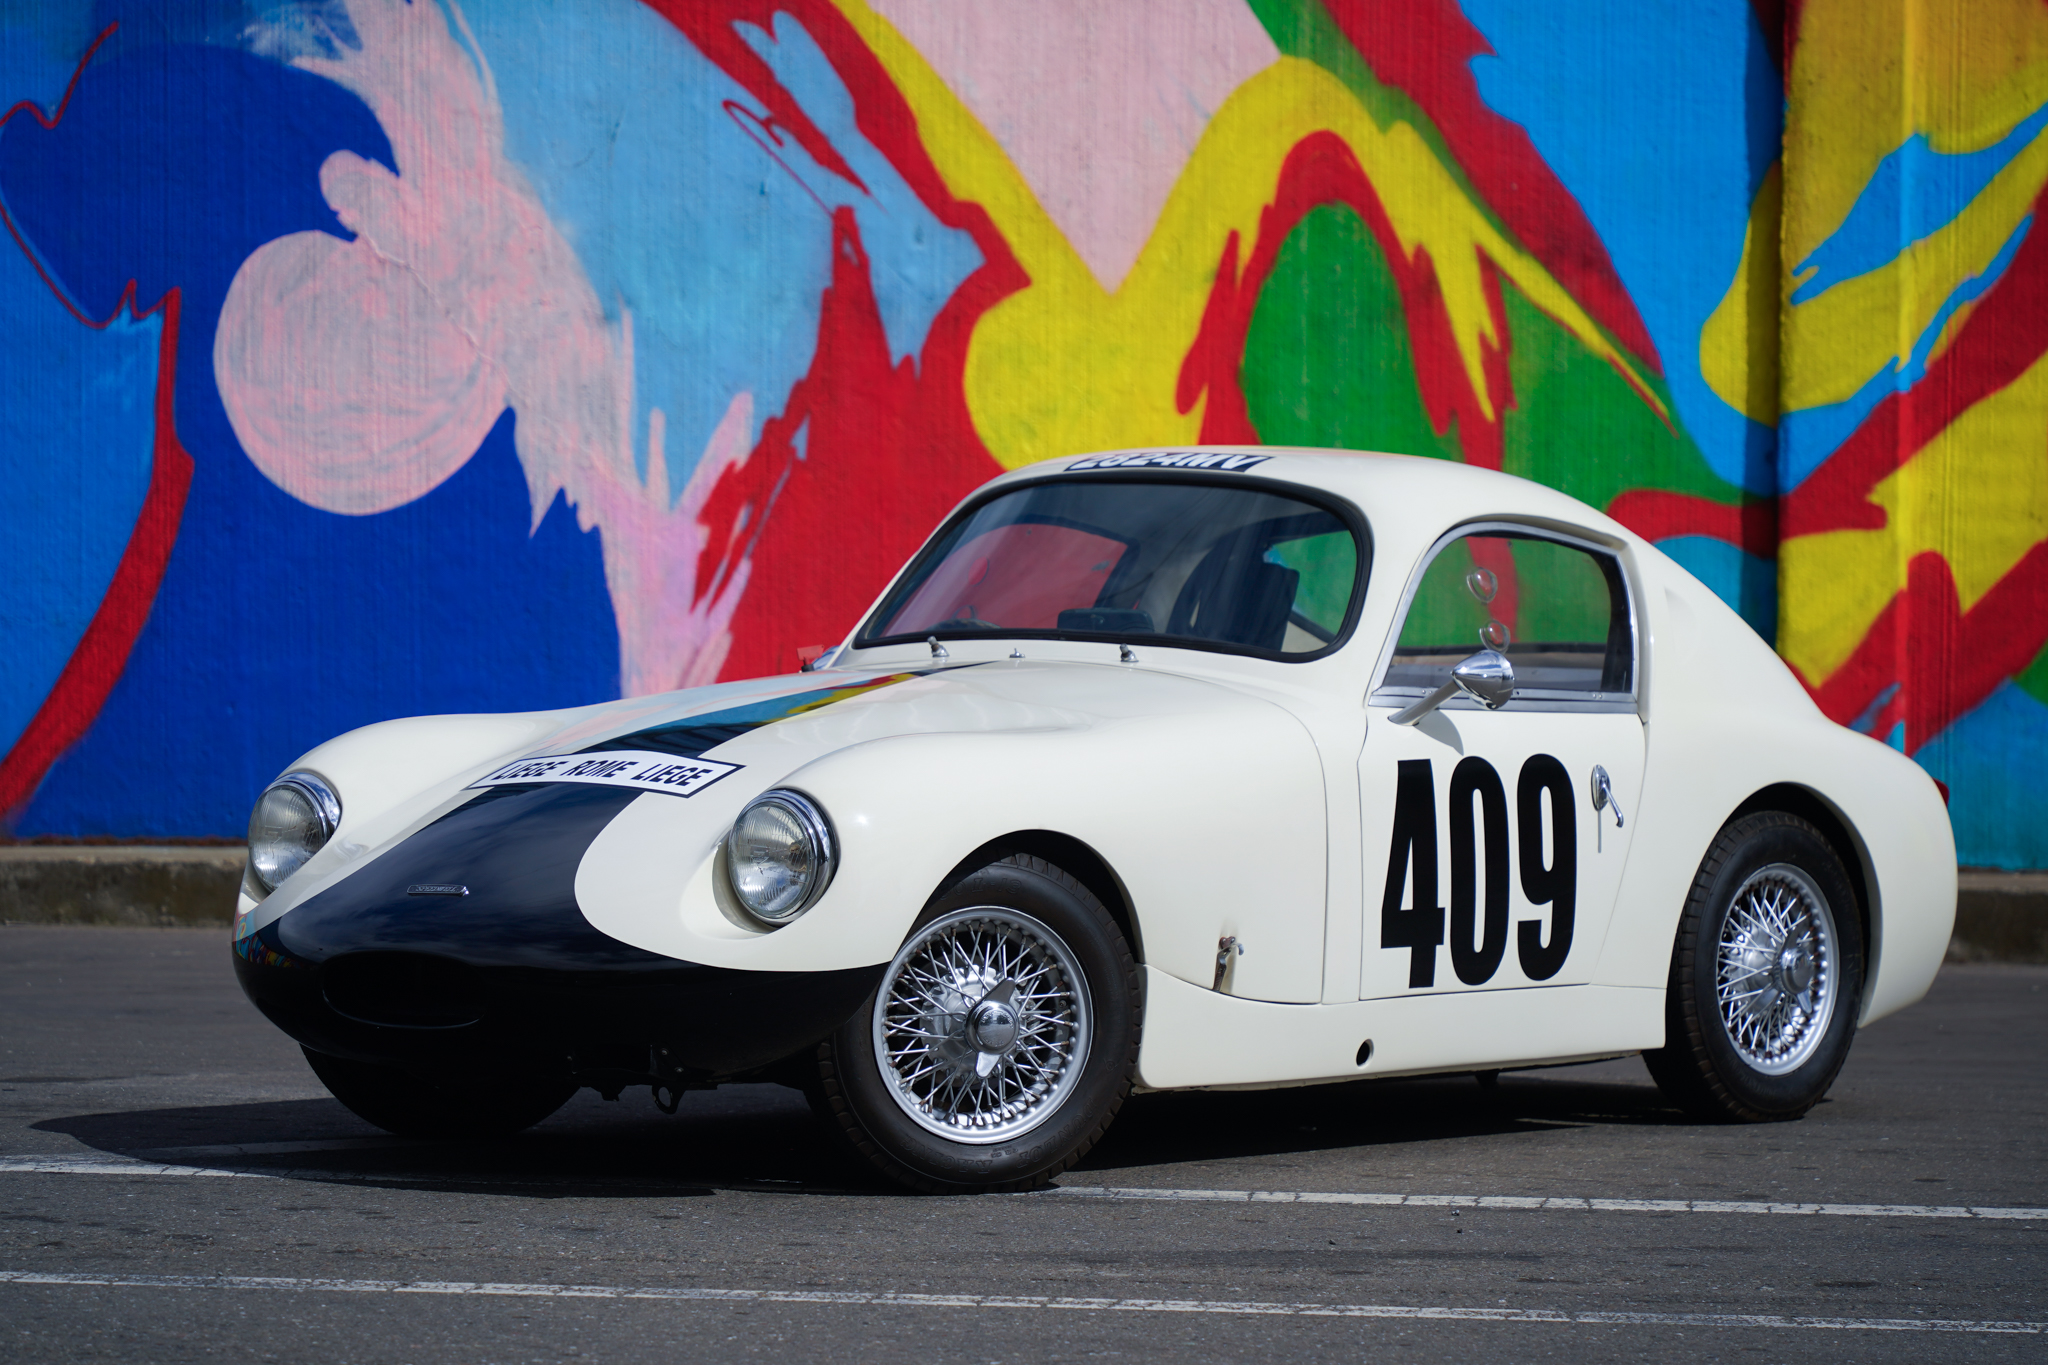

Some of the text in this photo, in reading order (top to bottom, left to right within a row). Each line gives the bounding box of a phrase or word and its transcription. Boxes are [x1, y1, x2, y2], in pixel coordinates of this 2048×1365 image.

[491, 759, 714, 787] LIEGE ROME LIEGE
[1380, 753, 1577, 989] 409
[900, 1096, 1097, 1174] DUNLOP RACING
